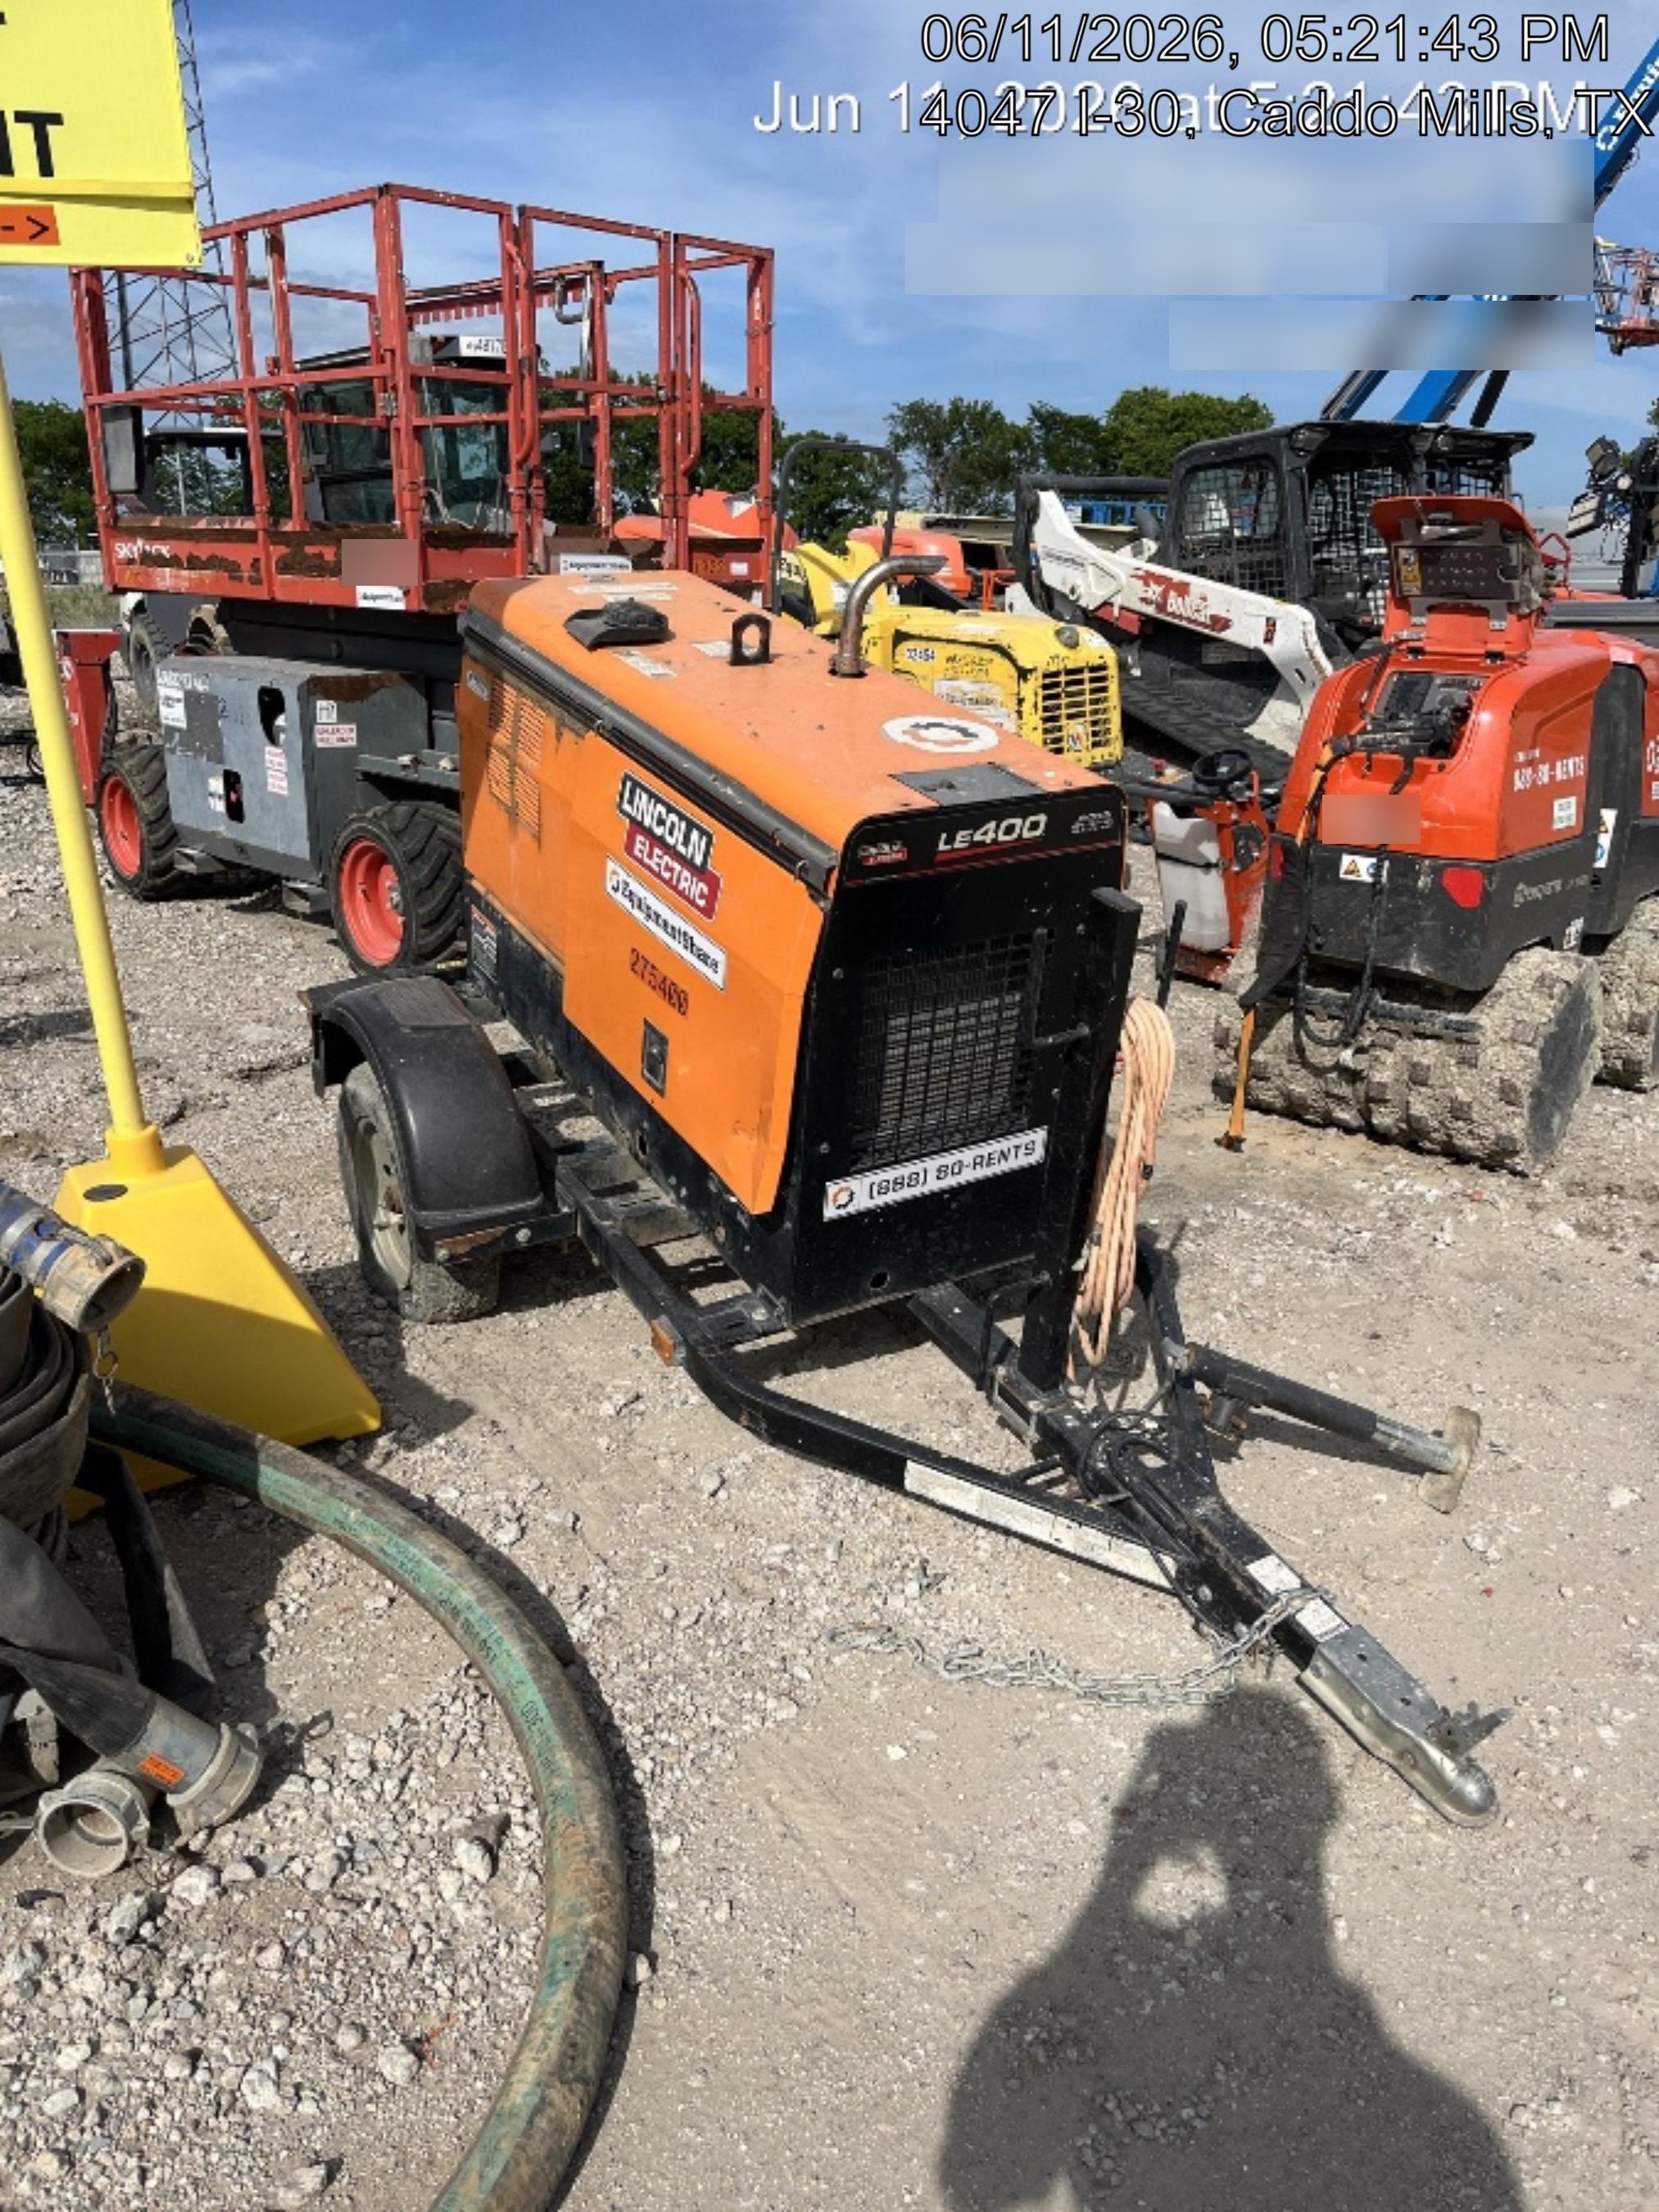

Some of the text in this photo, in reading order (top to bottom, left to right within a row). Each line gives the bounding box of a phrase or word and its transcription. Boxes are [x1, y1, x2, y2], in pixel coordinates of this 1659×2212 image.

[621, 780, 708, 867] LINCOLN
[937, 813, 1049, 852] LE400
[632, 832, 709, 909] ELECTRIC
[620, 878, 720, 975] EquipmentShare
[868, 1140, 1036, 1199] (888) 80-RENTS
